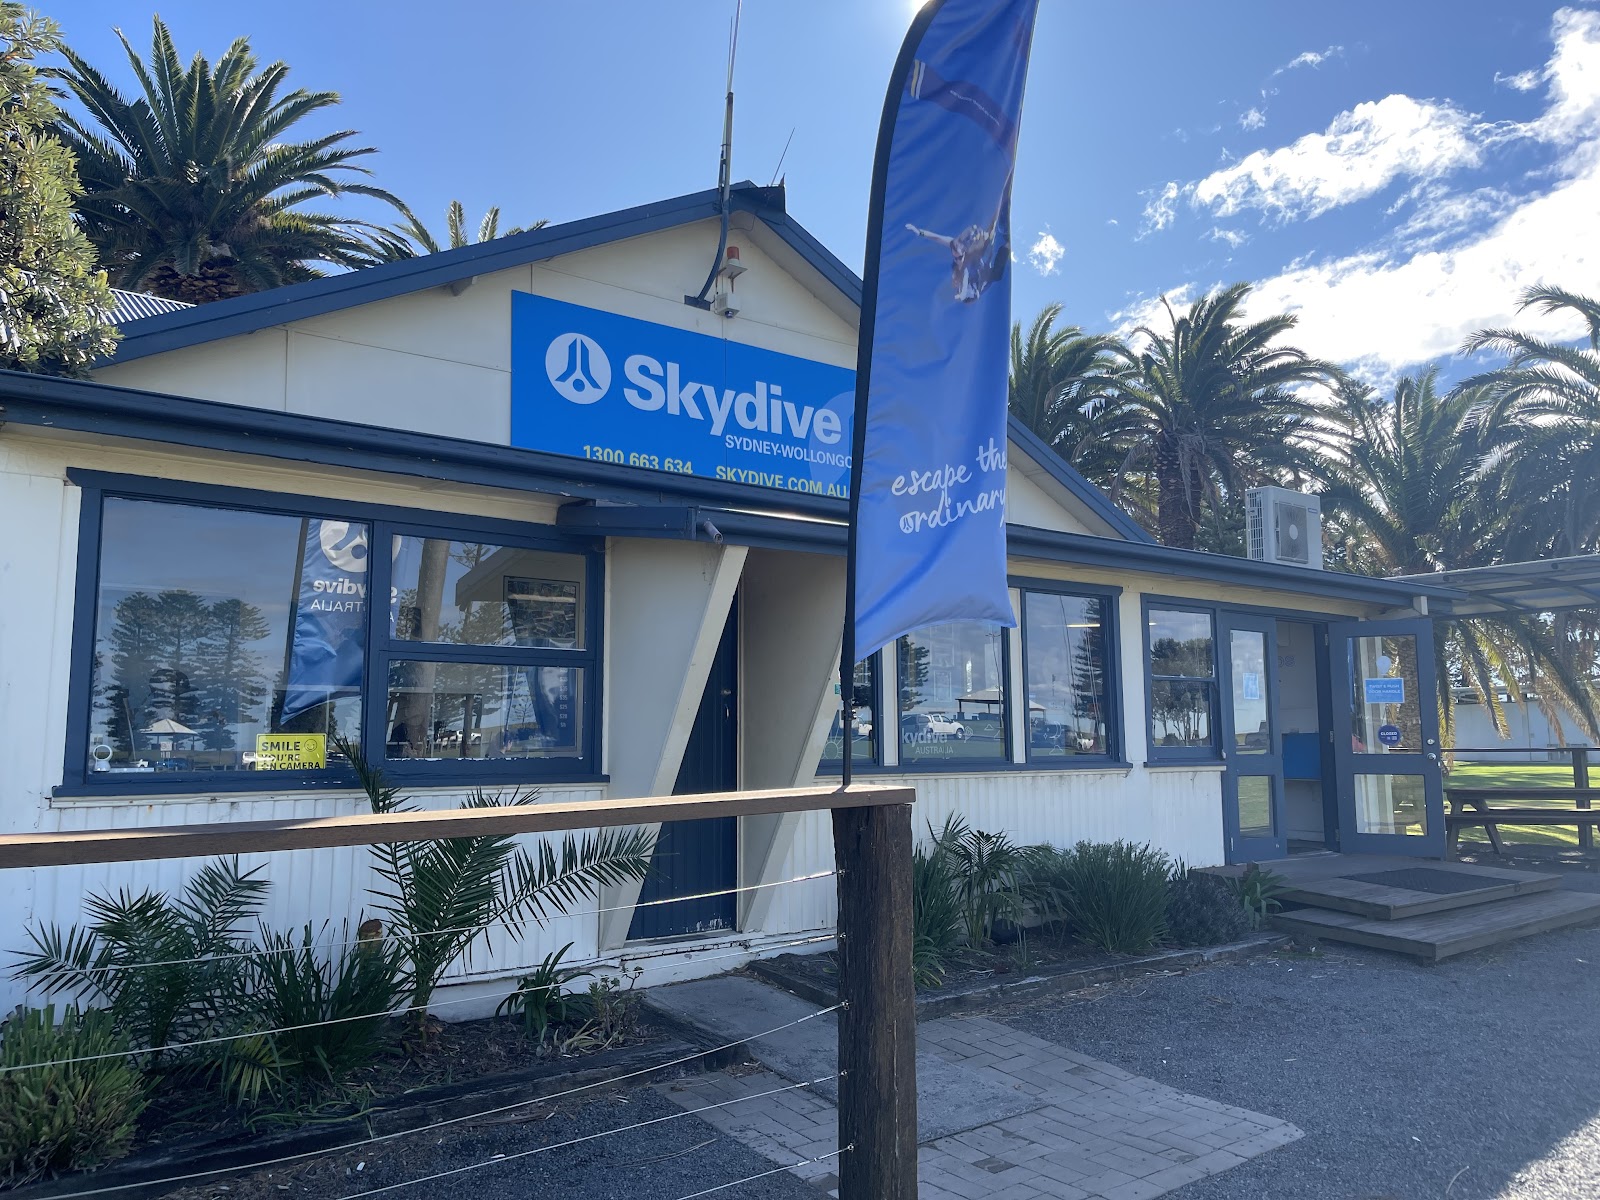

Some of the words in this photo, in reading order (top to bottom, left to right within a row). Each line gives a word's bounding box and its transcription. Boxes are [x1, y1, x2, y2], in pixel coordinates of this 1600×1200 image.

[624, 354, 841, 444] Skydive
[583, 445, 625, 464] 1300
[629, 453, 659, 470] 663
[664, 458, 693, 475] 634
[725, 434, 852, 468] SYDNEY-WOLLONGO
[715, 465, 847, 498] SKYDIVE.COM.AU
[891, 464, 972, 507] escape
[262, 742, 300, 751] SMILE
[902, 728, 947, 747] kydive
[262, 754, 300, 762] YOU'RE
[280, 762, 320, 770] CAMERA
